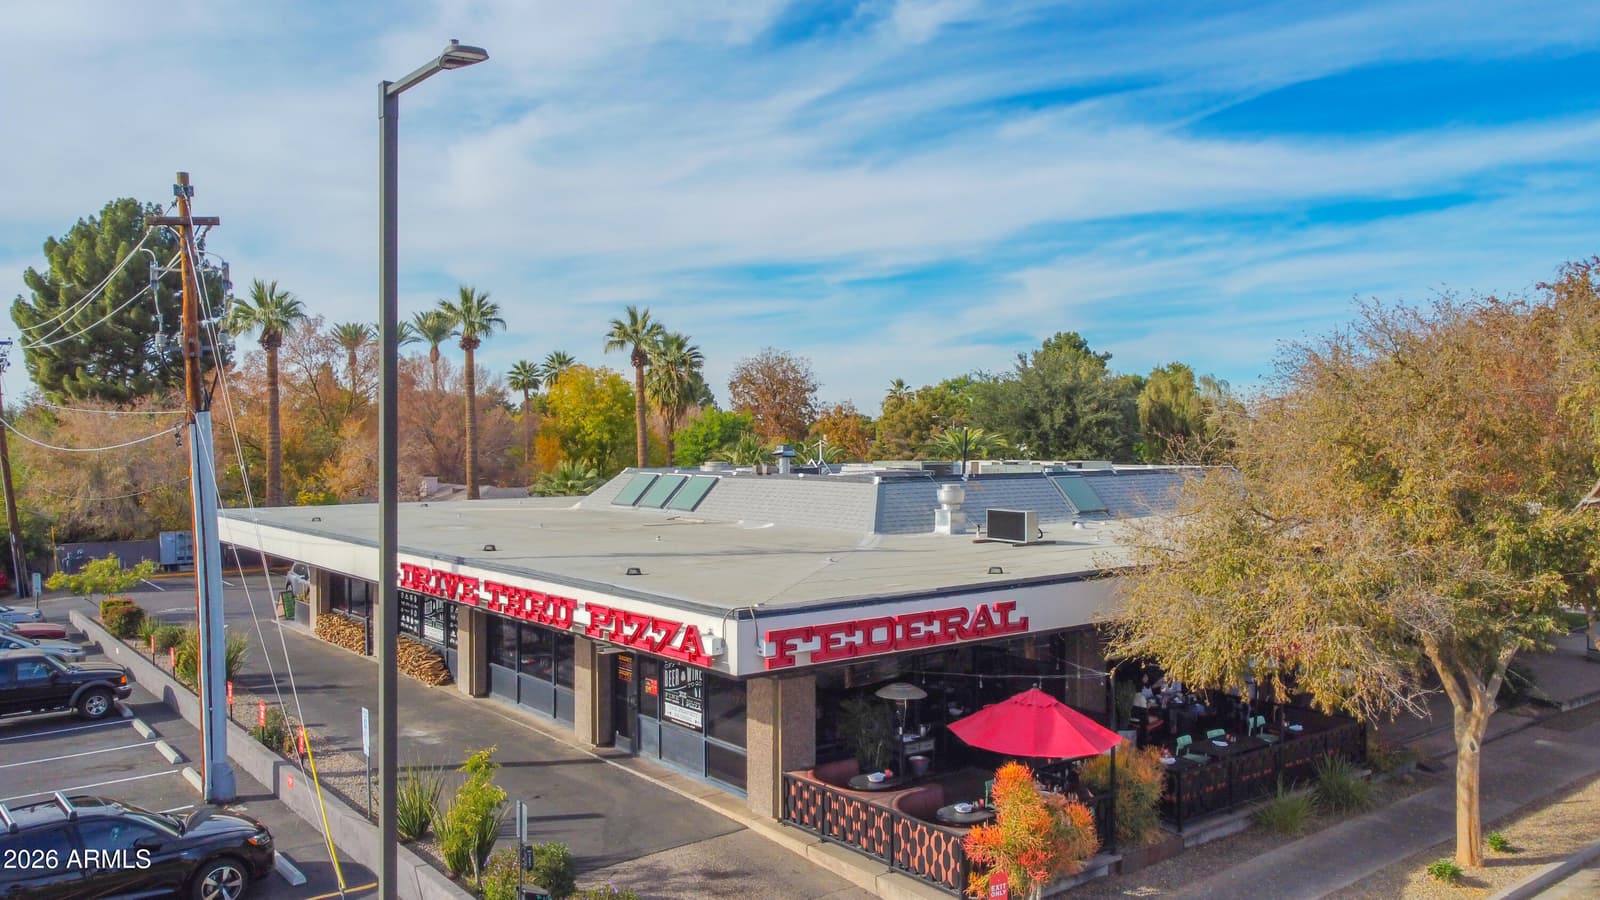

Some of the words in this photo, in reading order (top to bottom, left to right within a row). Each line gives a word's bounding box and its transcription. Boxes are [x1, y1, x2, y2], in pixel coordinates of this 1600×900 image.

[400, 562, 480, 606] DRIVE
[484, 579, 578, 630] THRU
[585, 602, 713, 668] PIZZA
[765, 600, 1029, 670] FEDERAL
[991, 883, 1006, 891] EXIT
[991, 889, 1006, 897] ONLY
